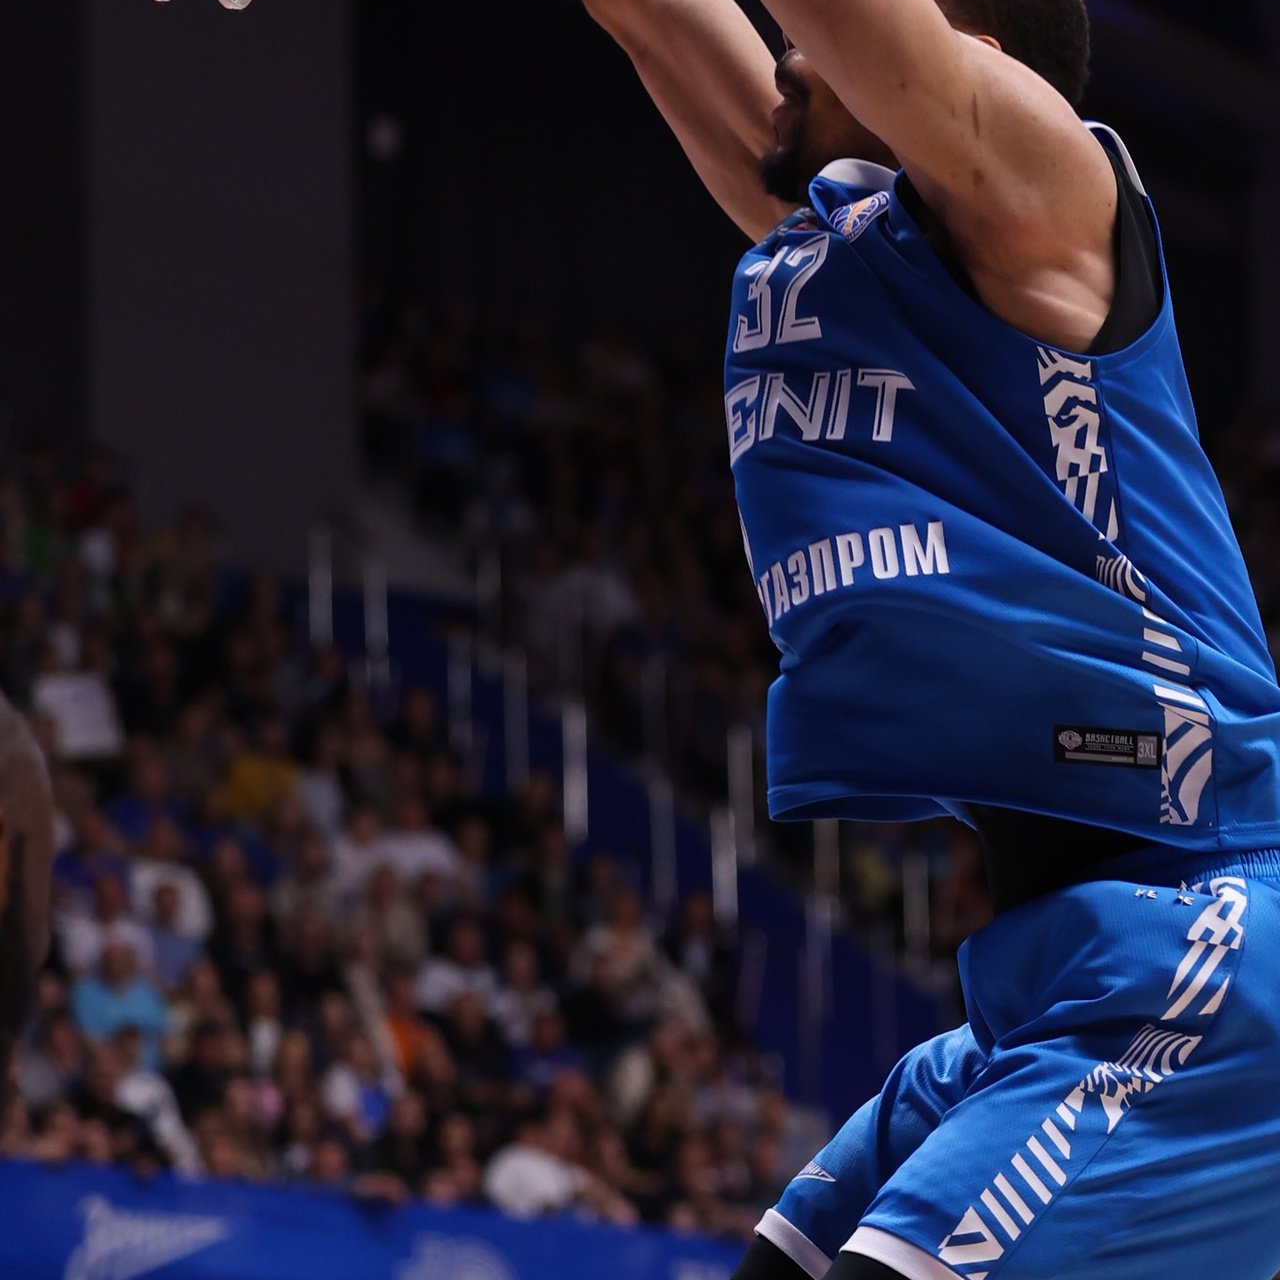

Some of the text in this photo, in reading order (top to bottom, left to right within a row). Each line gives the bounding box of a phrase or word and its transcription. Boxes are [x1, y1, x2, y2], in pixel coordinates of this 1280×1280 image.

[733, 233, 830, 354] 32
[1085, 733, 1134, 745] BASKETBALL
[1137, 742, 1156, 759] 3XL
